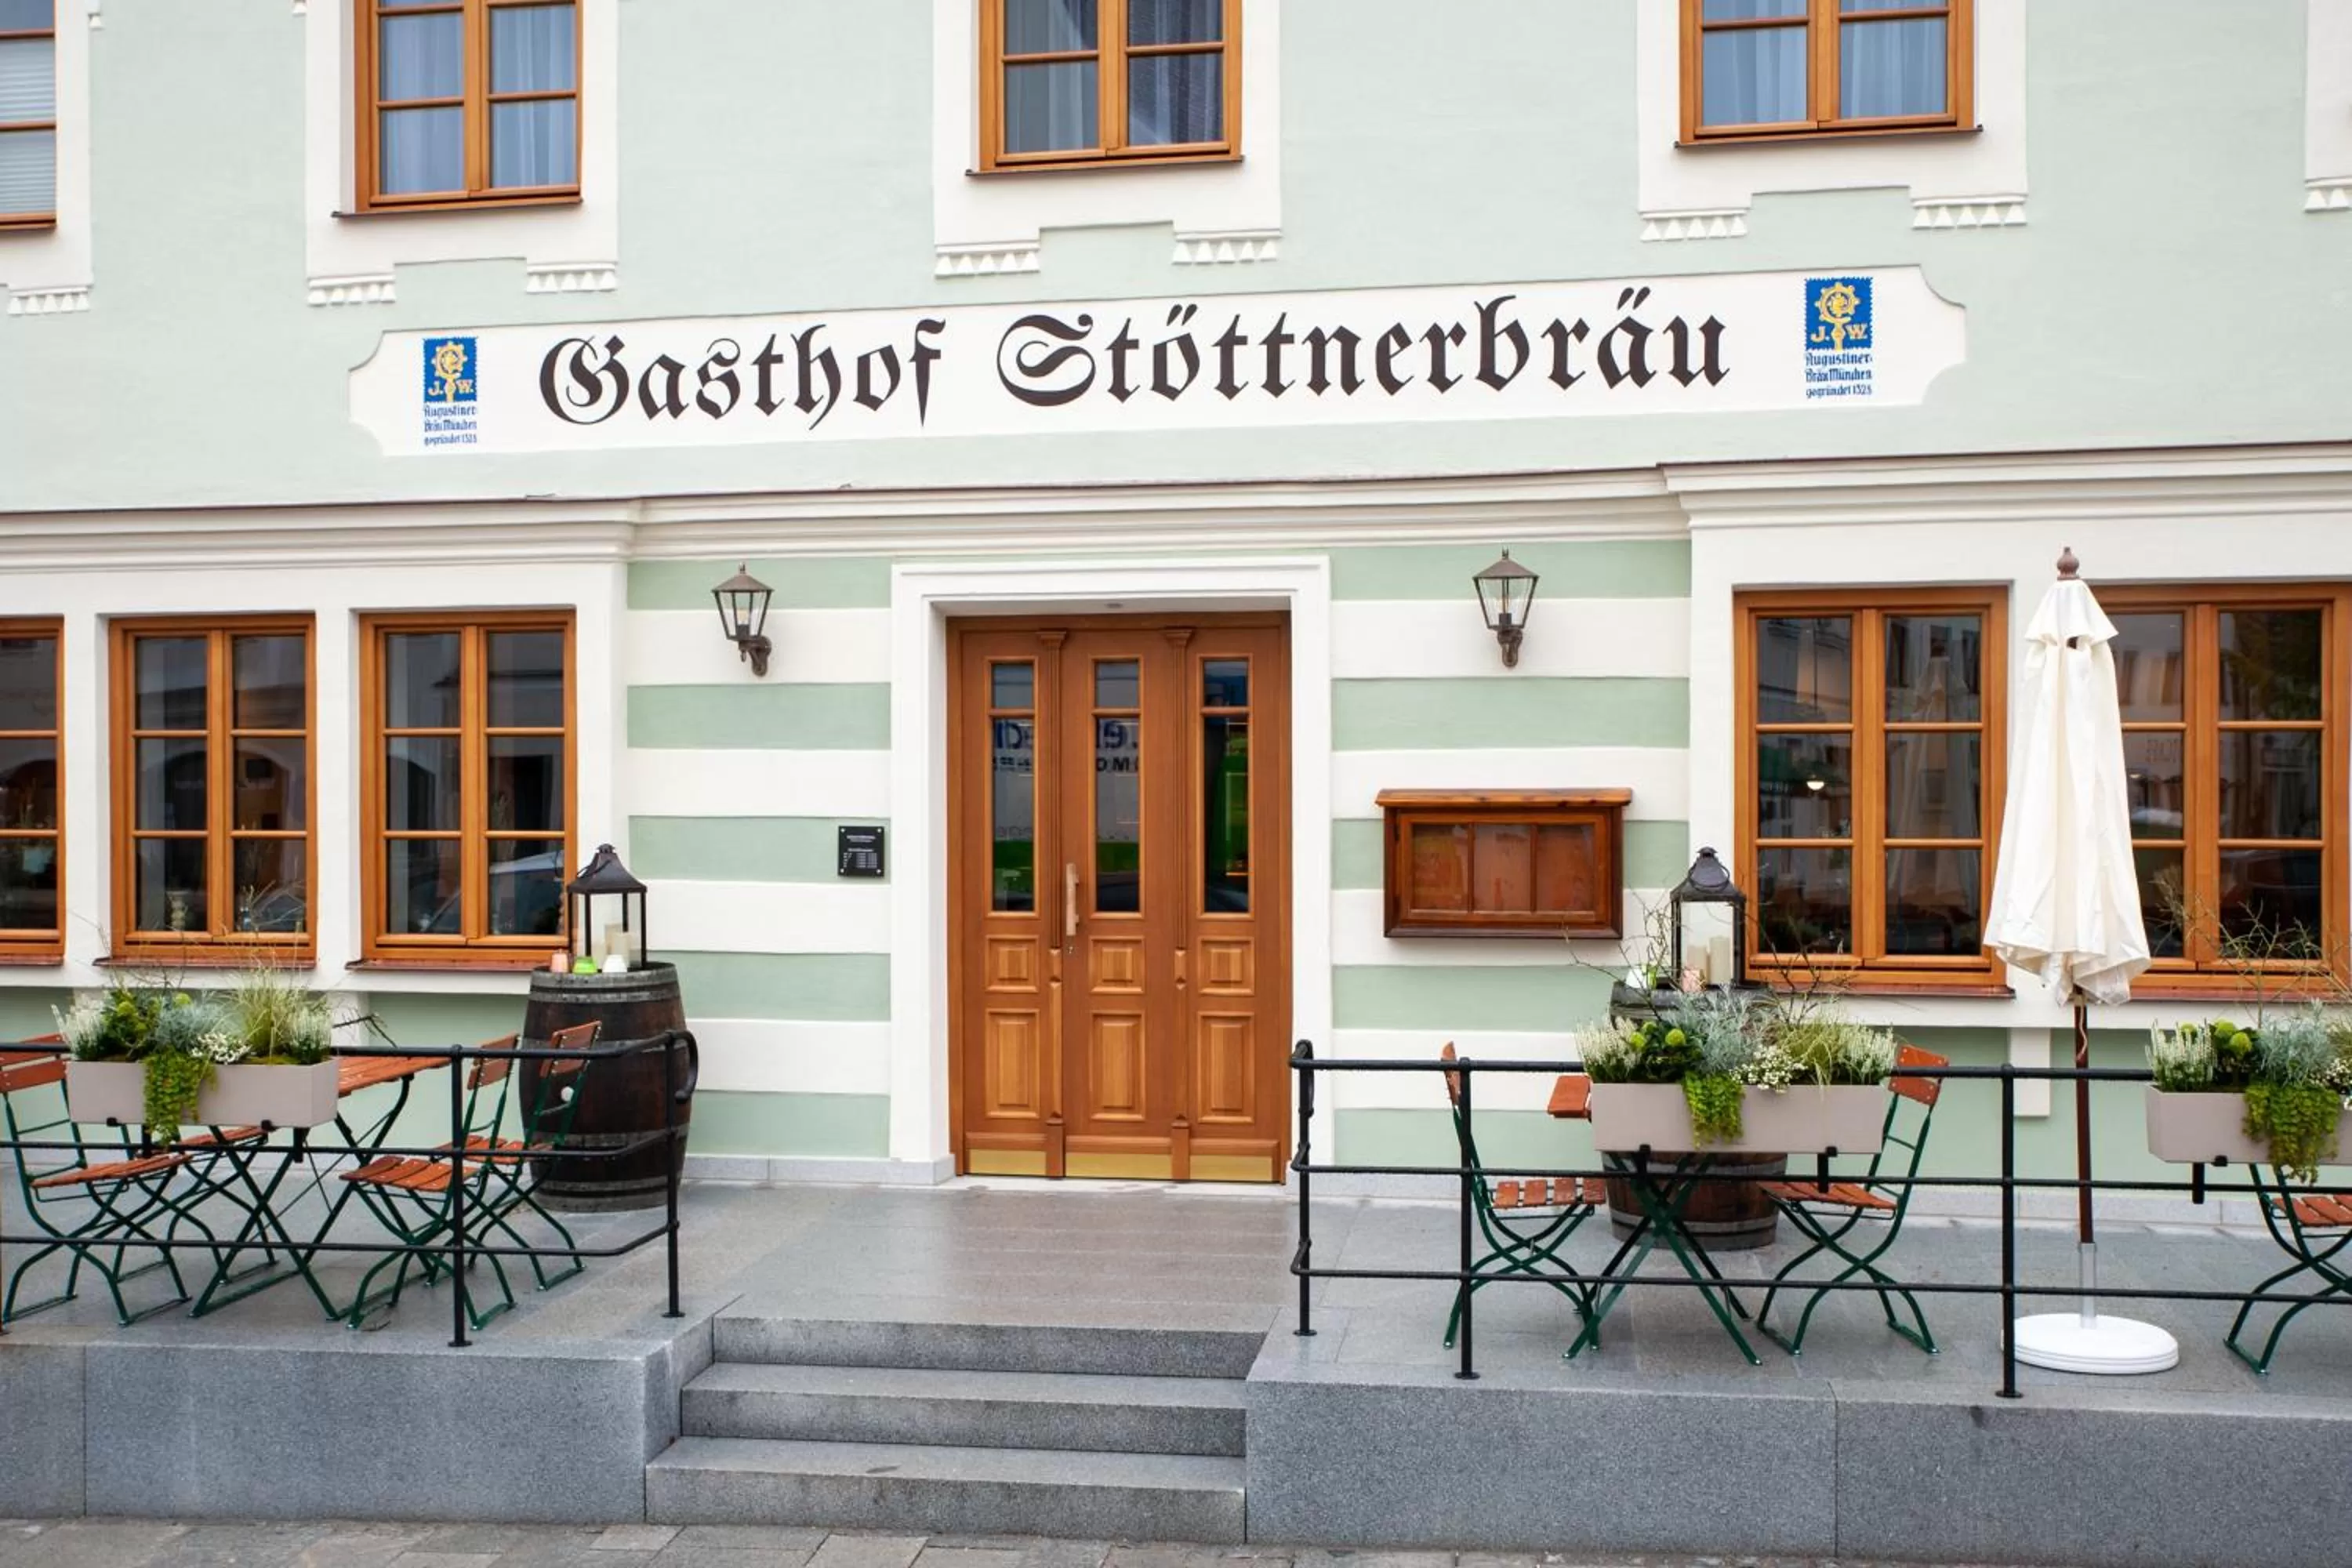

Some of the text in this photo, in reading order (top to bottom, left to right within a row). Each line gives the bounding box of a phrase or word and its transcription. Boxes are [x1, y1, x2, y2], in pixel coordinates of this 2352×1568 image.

[539, 287, 1731, 430] Gasthof Stöttnerbräu
[1829, 368, 1872, 381] München
